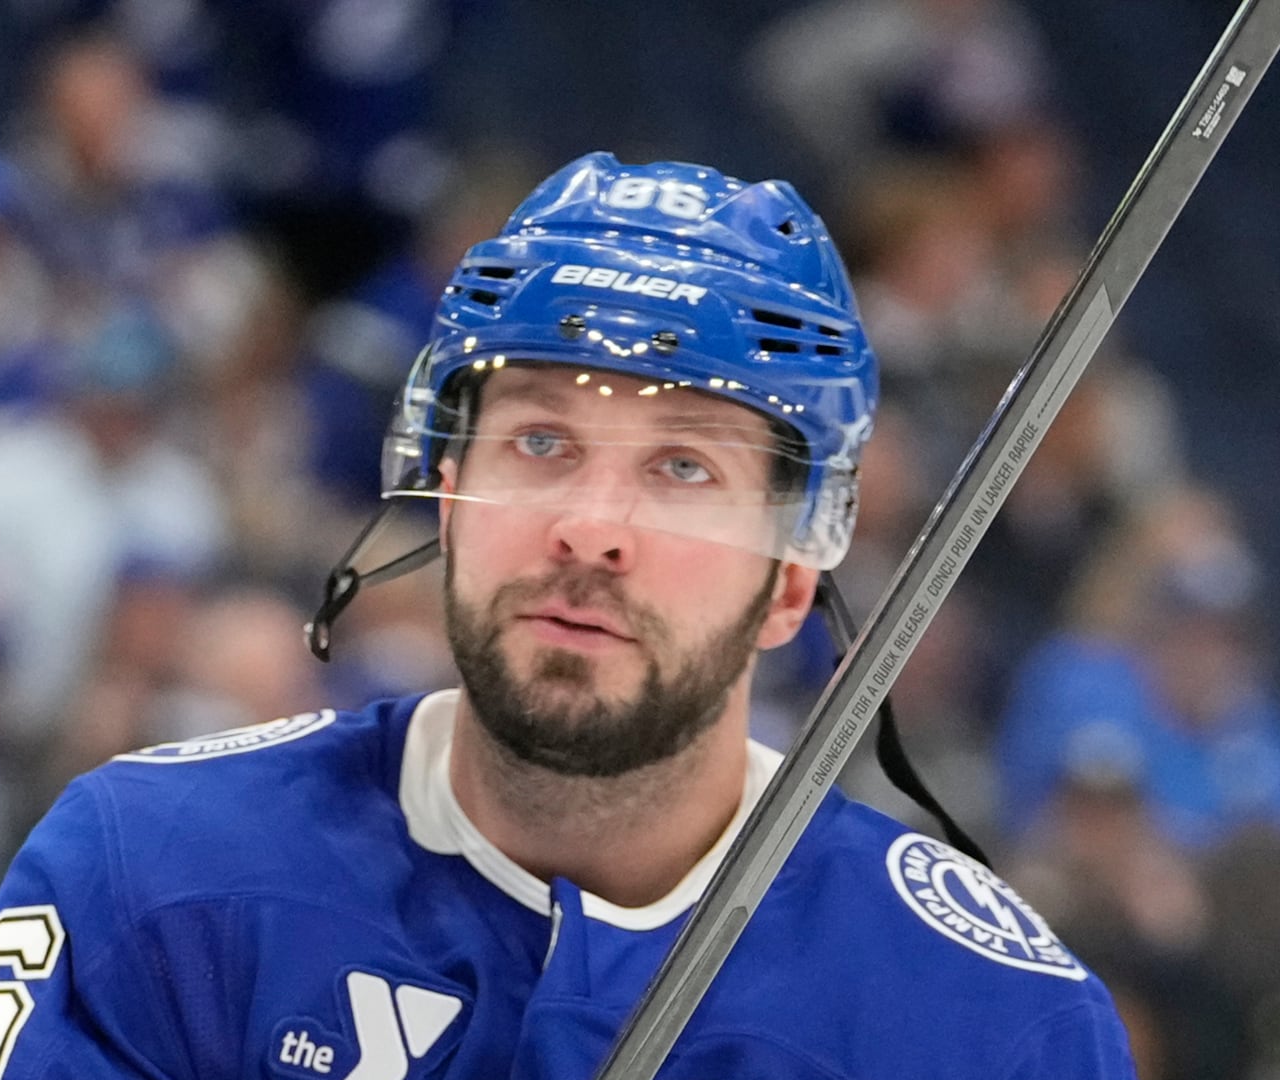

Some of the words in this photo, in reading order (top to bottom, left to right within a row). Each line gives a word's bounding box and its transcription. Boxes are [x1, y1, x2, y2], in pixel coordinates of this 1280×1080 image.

[606, 177, 710, 221] 86
[812, 719, 858, 785] ENGINEERED
[853, 695, 873, 720] FOR
[873, 651, 900, 686] QUICK
[895, 604, 929, 650] RELEASE
[952, 525, 977, 558] POUR
[972, 505, 988, 526] UN
[983, 463, 1015, 507] LANCER
[1009, 422, 1039, 463] RAPIDE
[903, 846, 932, 884] BAY
[915, 887, 1009, 954] TAMPA
[279, 1030, 334, 1074] the
